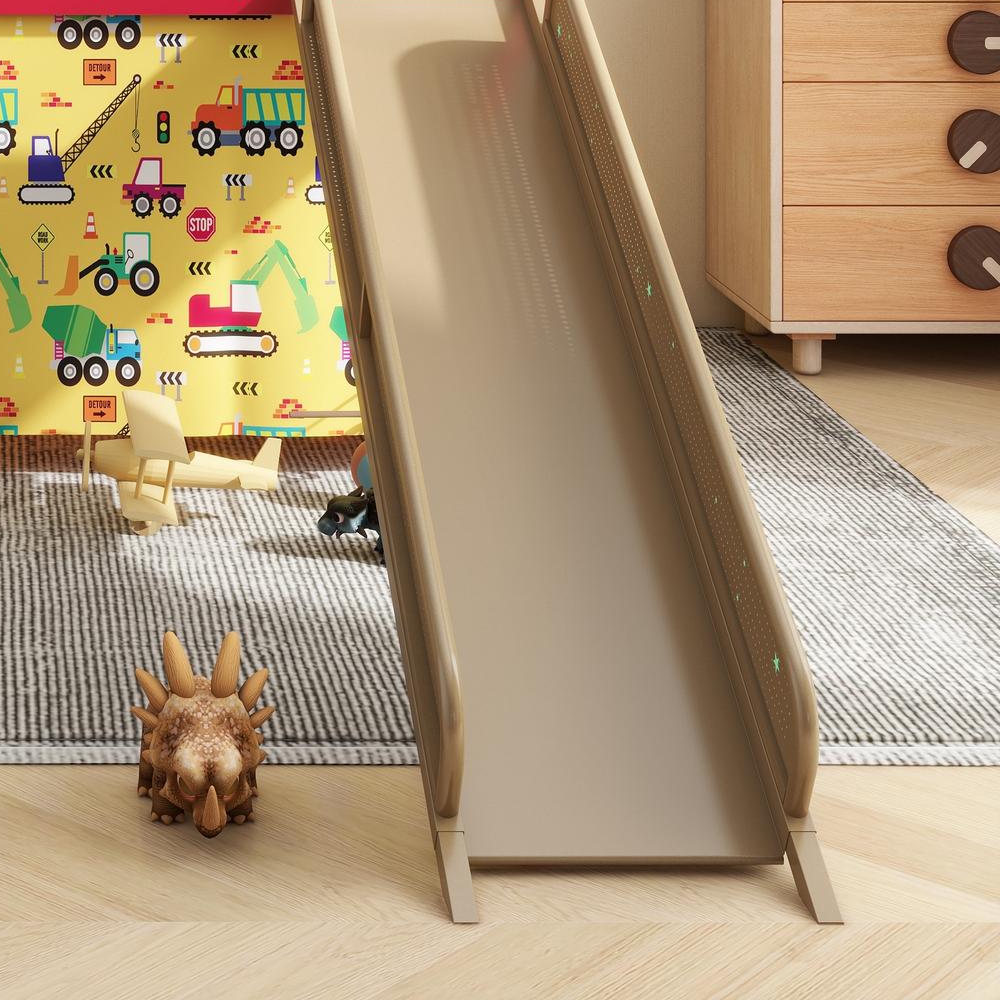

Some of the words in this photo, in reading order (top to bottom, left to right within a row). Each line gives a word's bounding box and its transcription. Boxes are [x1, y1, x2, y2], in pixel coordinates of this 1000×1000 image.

[88, 63, 112, 72] DETOUR
[189, 217, 213, 232] STOP
[88, 400, 112, 408] DETOUR
